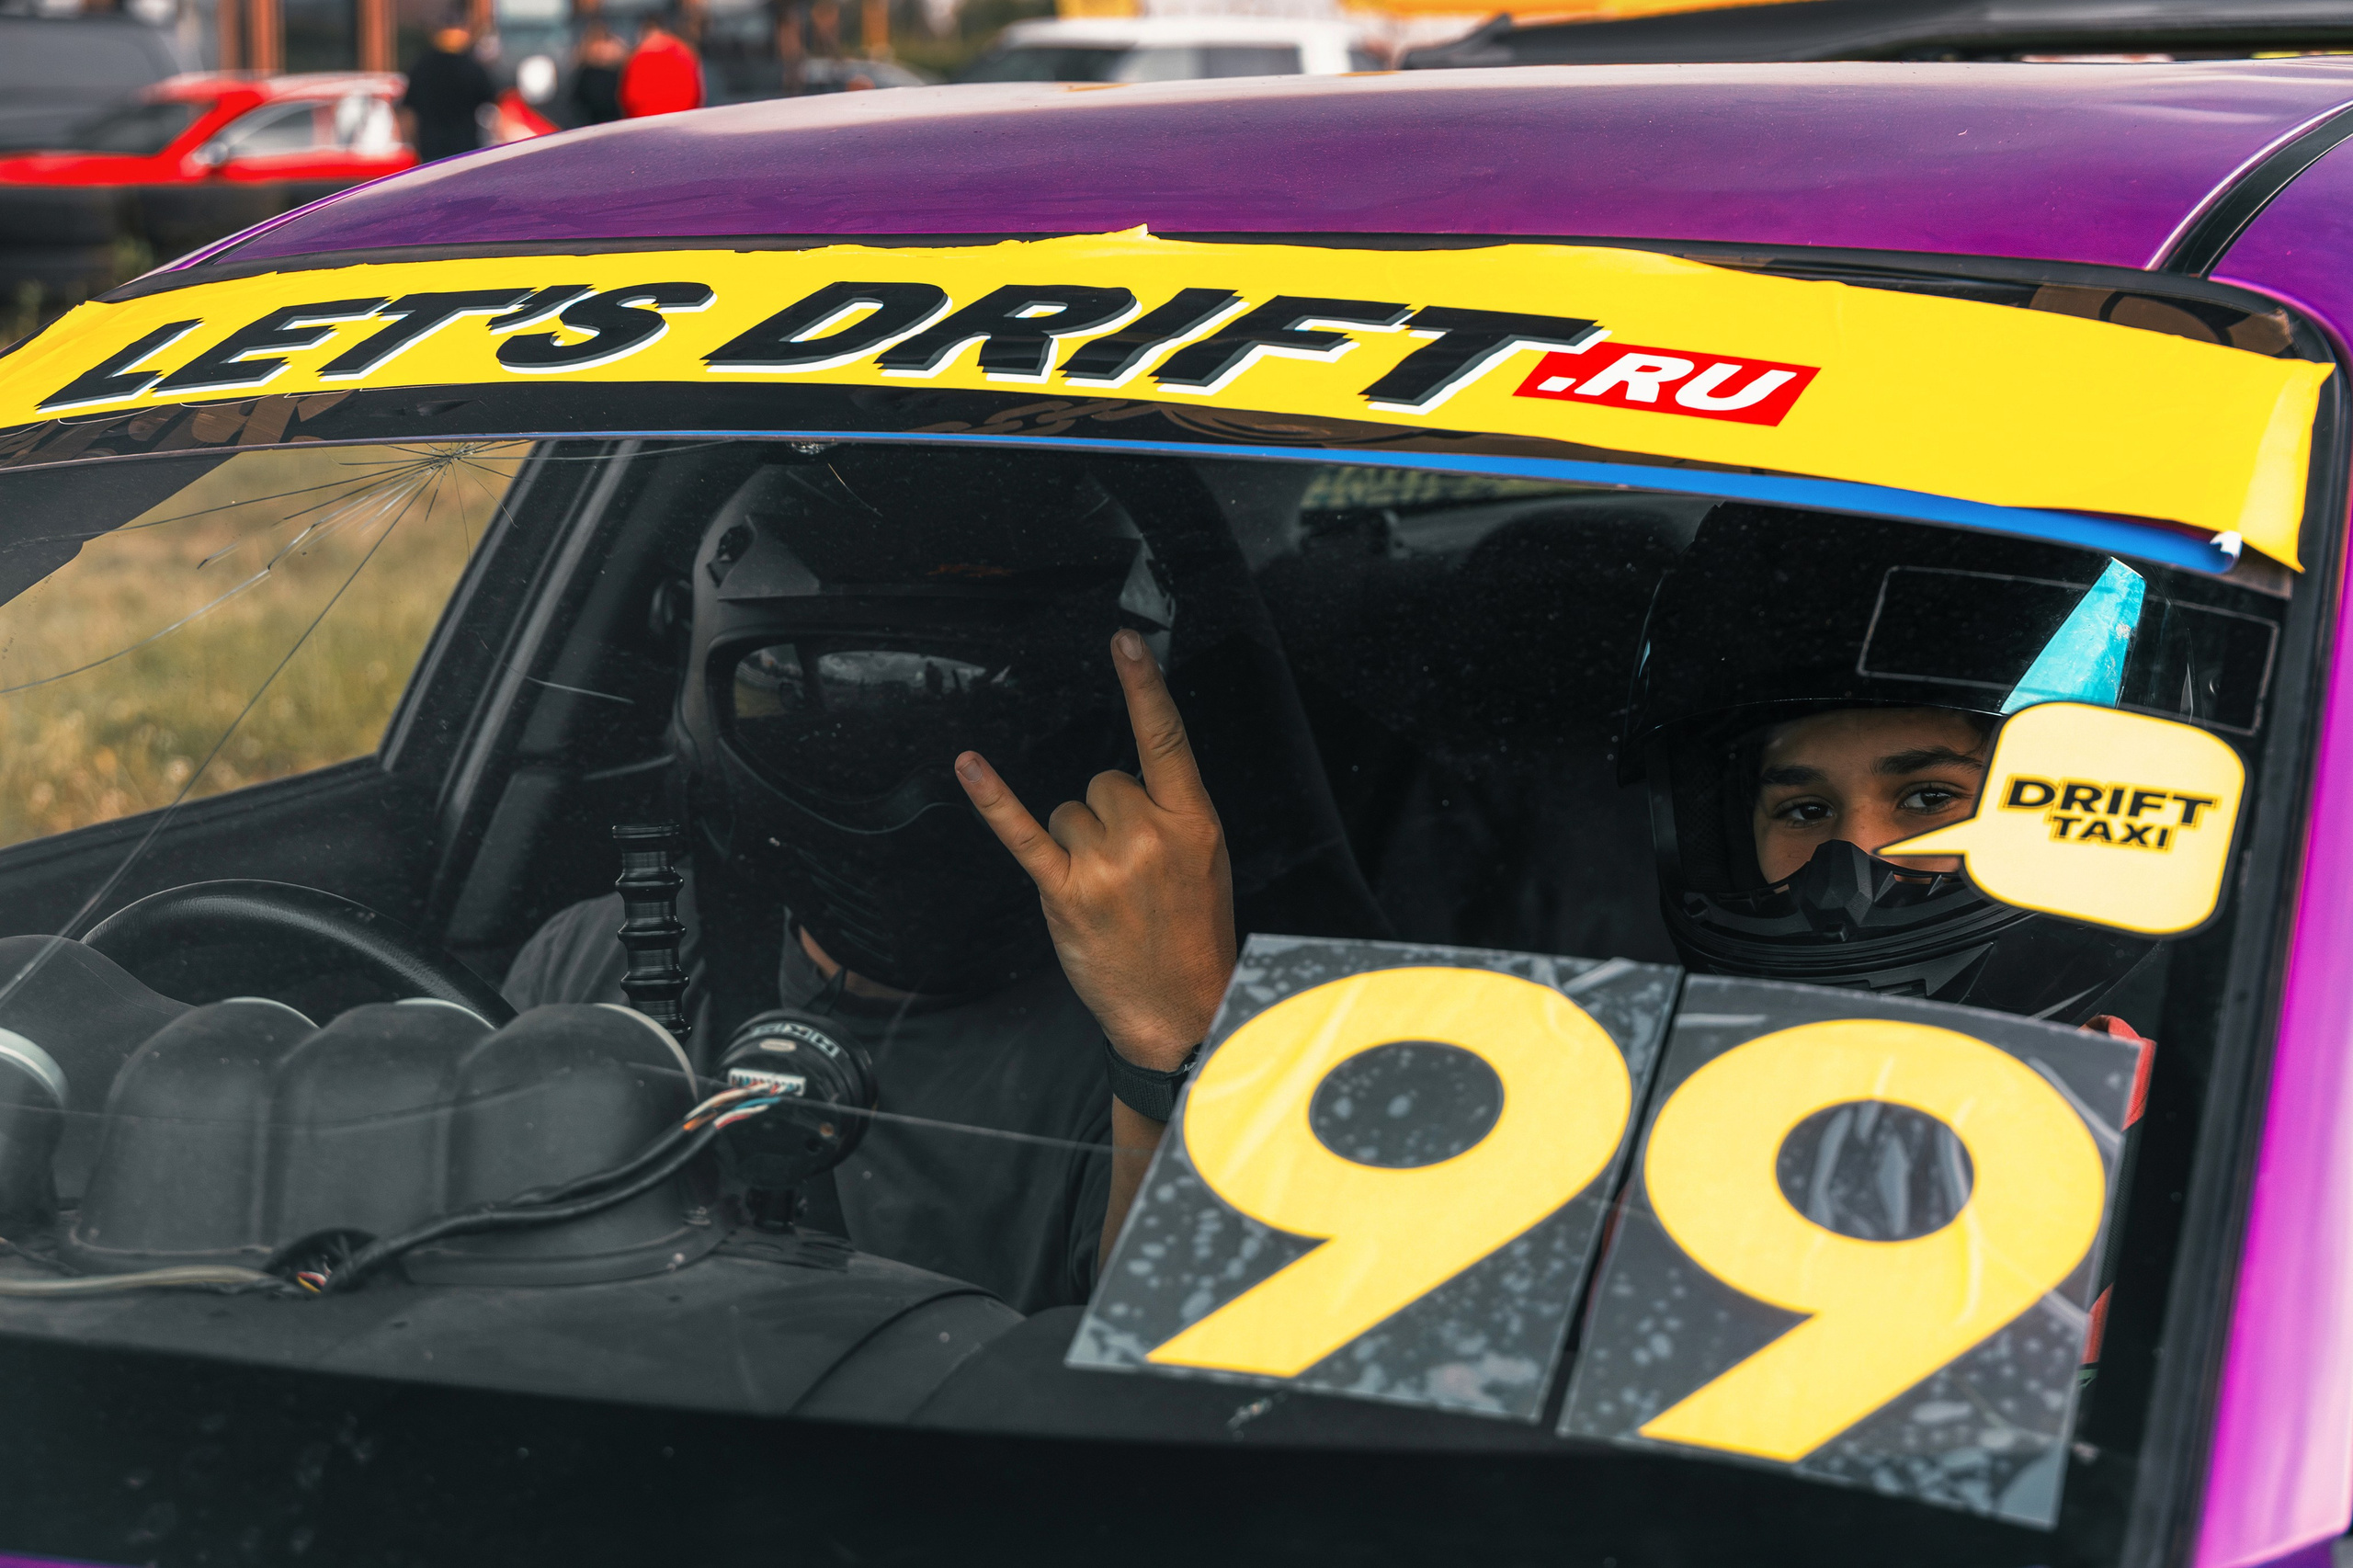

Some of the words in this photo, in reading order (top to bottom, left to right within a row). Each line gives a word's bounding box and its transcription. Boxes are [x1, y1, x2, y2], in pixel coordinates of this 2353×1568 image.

[37, 282, 713, 414] LET'S
[2004, 778, 2218, 827] DRIFT
[2049, 815, 2169, 850] TAXI
